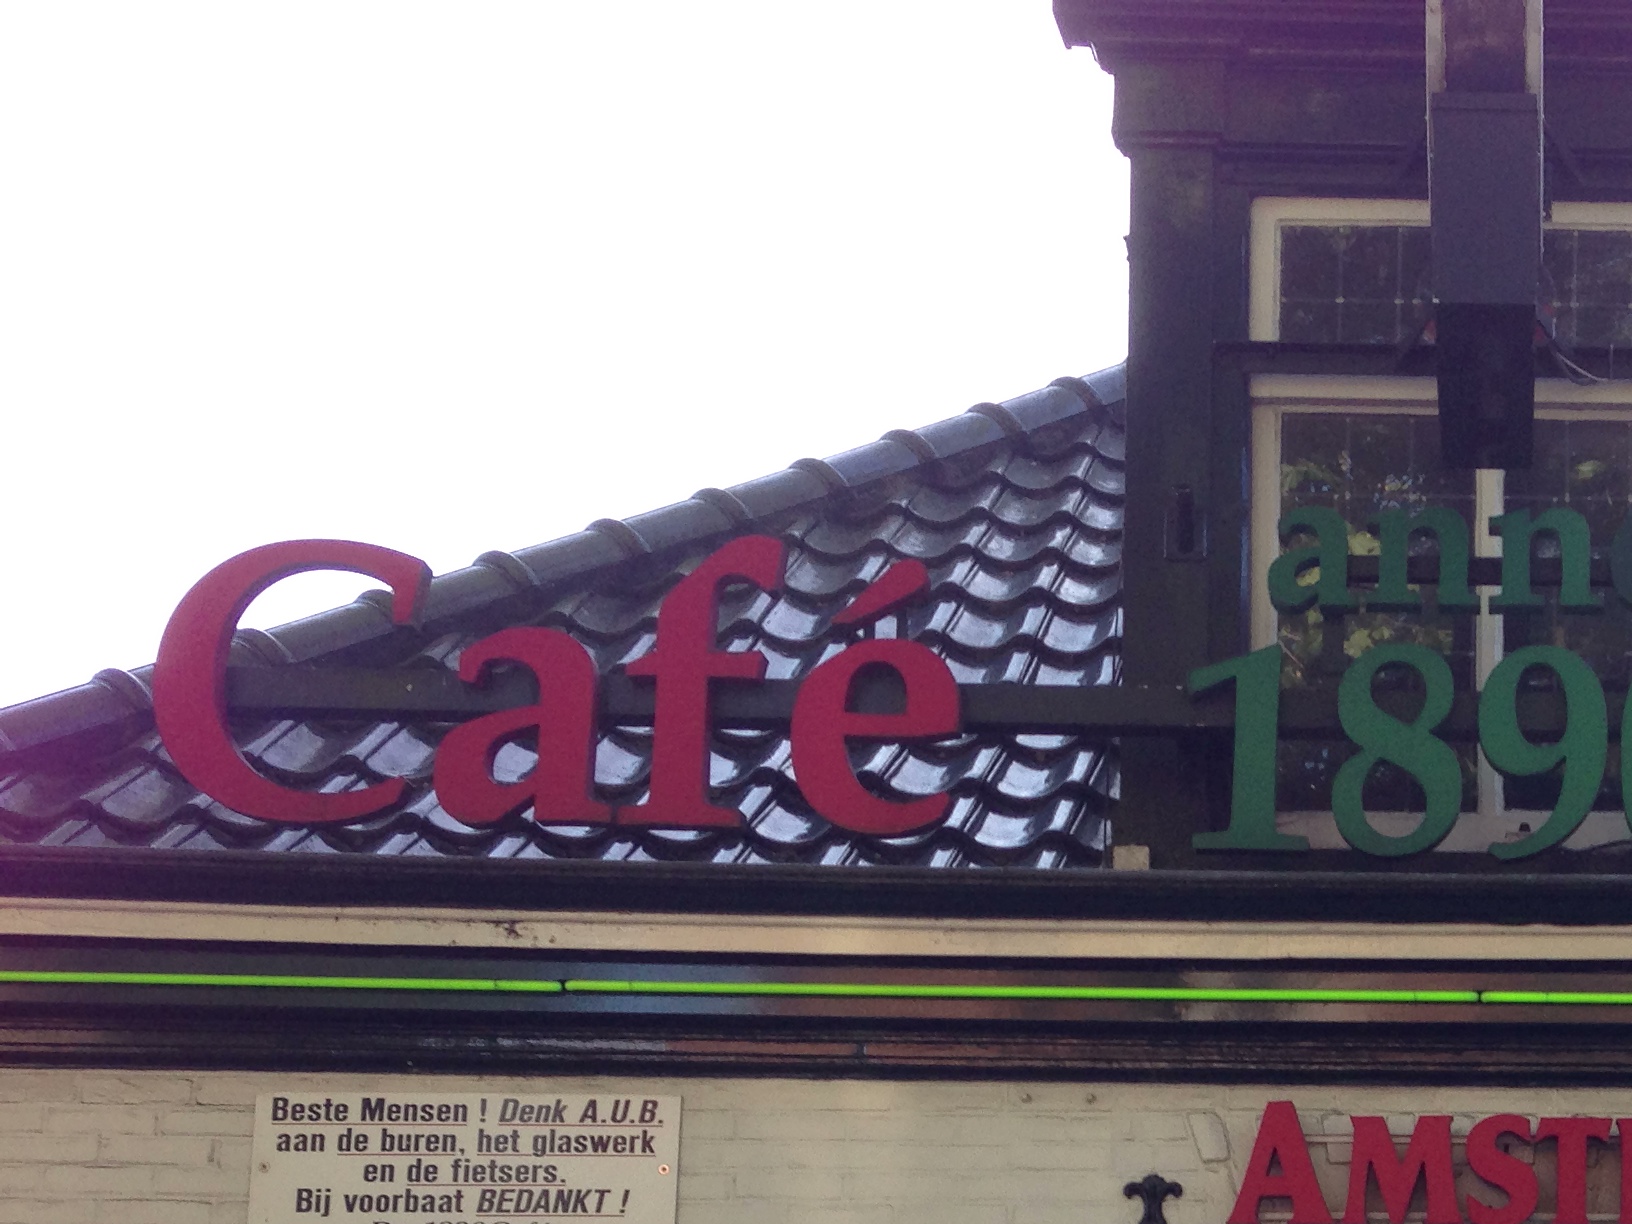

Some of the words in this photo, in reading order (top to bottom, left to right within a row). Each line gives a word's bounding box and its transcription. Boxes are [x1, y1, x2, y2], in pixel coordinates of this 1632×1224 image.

[150, 534, 962, 839] Café
[271, 1097, 349, 1122] Beste
[360, 1097, 468, 1122] Mensen
[498, 1099, 567, 1124] Denk
[578, 1100, 664, 1125] A.U.B.
[276, 1133, 326, 1152] aan
[336, 1130, 368, 1153] de
[381, 1130, 465, 1155] buren,
[477, 1130, 520, 1154] het
[532, 1130, 656, 1158] glaswerk
[363, 1164, 394, 1183] en
[407, 1160, 439, 1183] de
[451, 1159, 566, 1184] fietsers.
[295, 1188, 331, 1217] Bij
[344, 1189, 464, 1213] voorbaat
[476, 1189, 611, 1214] BEDANKT
